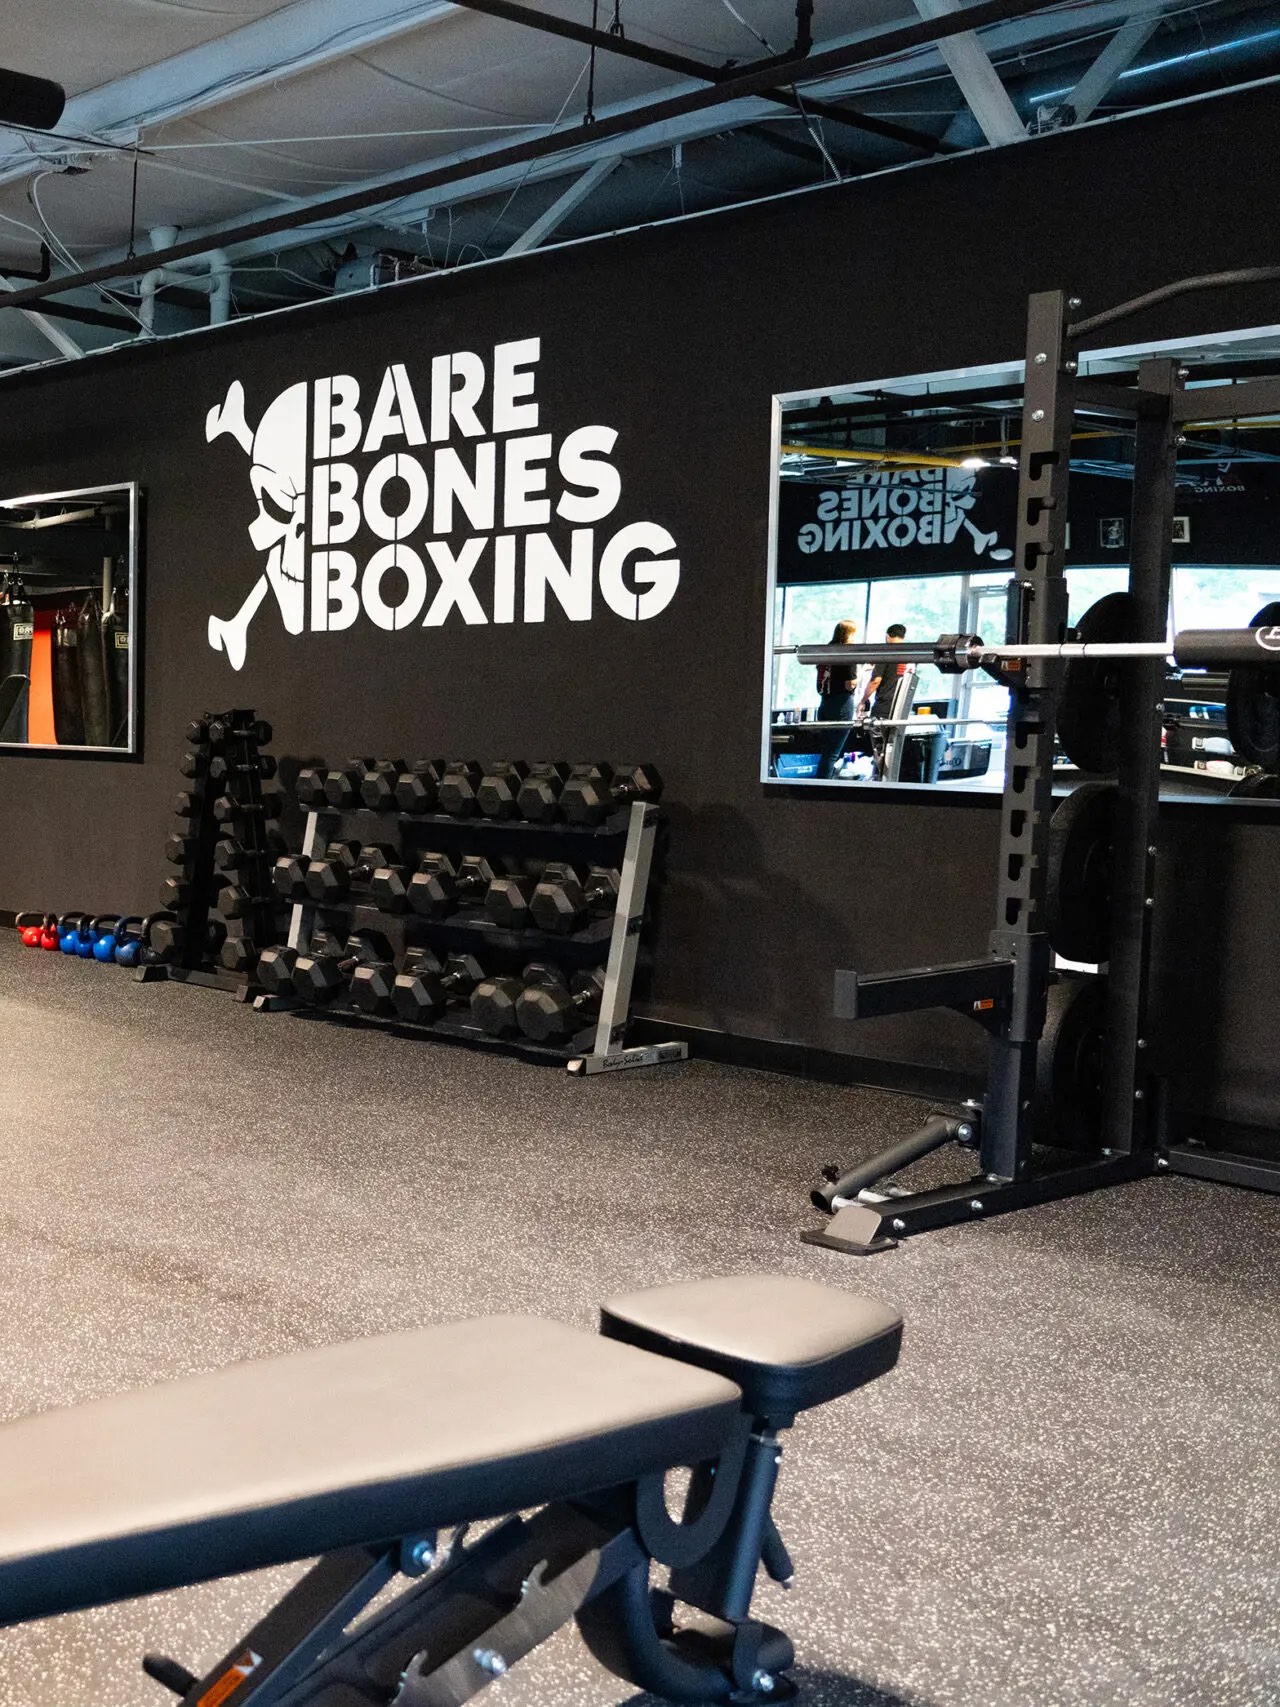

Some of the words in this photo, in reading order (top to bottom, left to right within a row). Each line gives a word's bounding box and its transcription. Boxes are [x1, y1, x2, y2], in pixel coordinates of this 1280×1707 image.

[313, 336, 541, 460] BARE
[312, 425, 622, 546] BONES
[310, 520, 682, 632] BOXING
